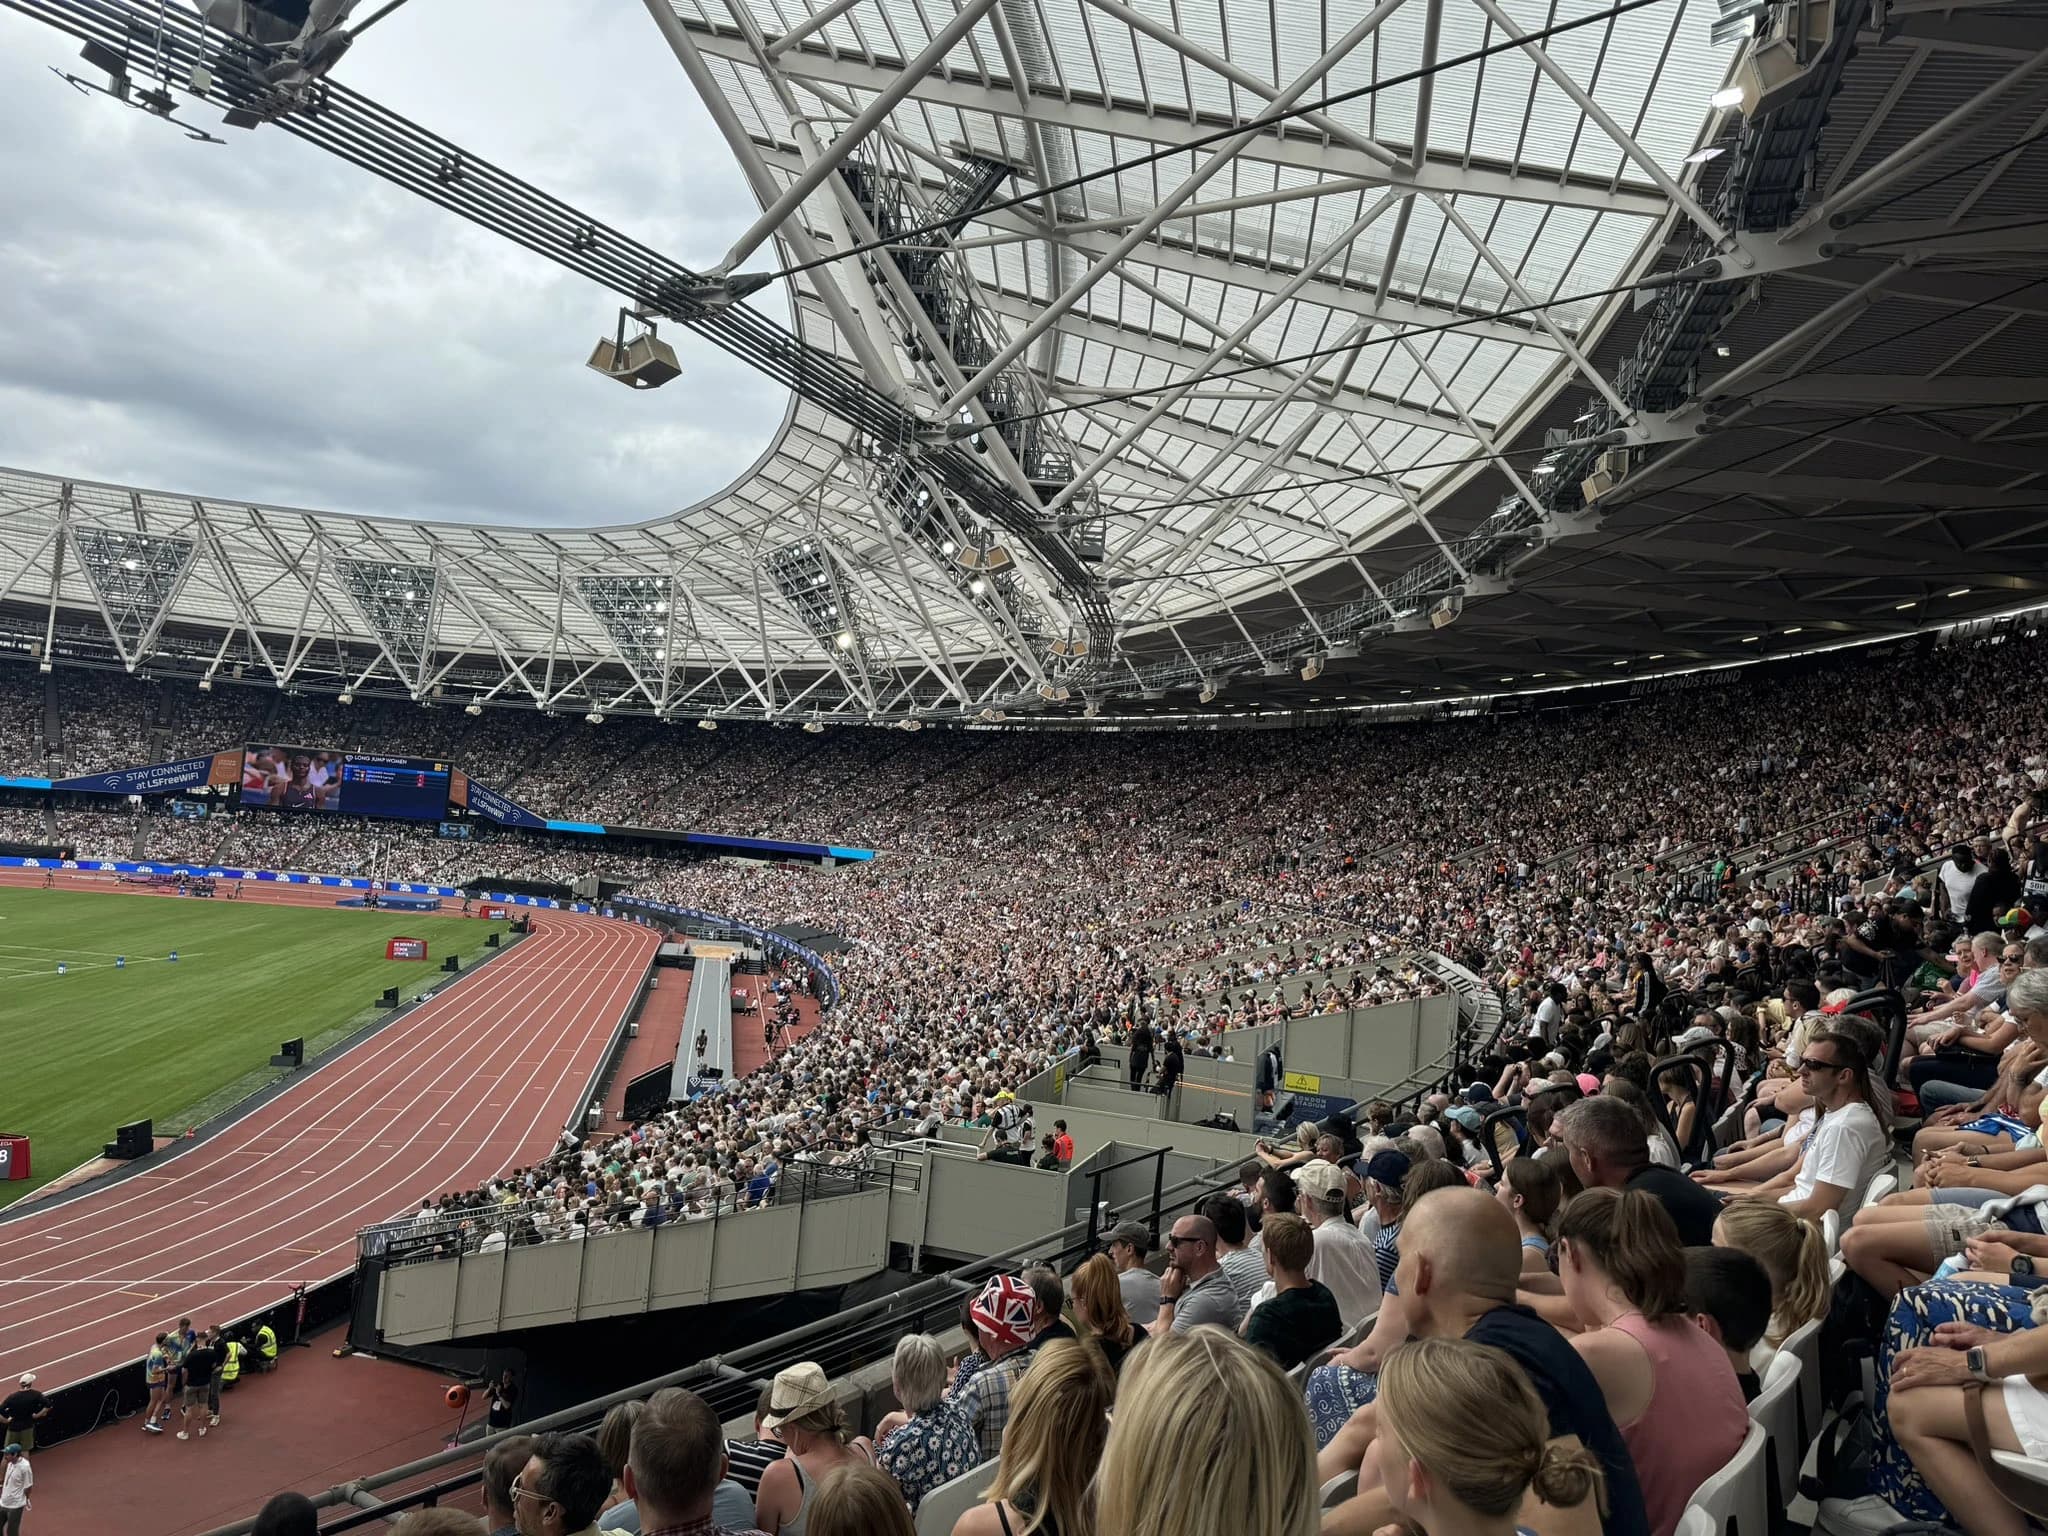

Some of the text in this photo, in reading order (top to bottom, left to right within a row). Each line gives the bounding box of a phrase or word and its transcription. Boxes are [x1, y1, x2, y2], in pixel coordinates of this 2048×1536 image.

[1630, 682, 1660, 696] BILLY
[1702, 671, 1742, 686] STAND
[126, 770, 150, 782] STAY
[151, 760, 206, 778] CONNECTED
[136, 781, 147, 790] at
[470, 784, 512, 813] STAY CONNECTED
[1294, 1101, 1327, 1109] STADIUM
[1295, 1096, 1327, 1104] LONDON
[0, 1149, 8, 1163] 8
